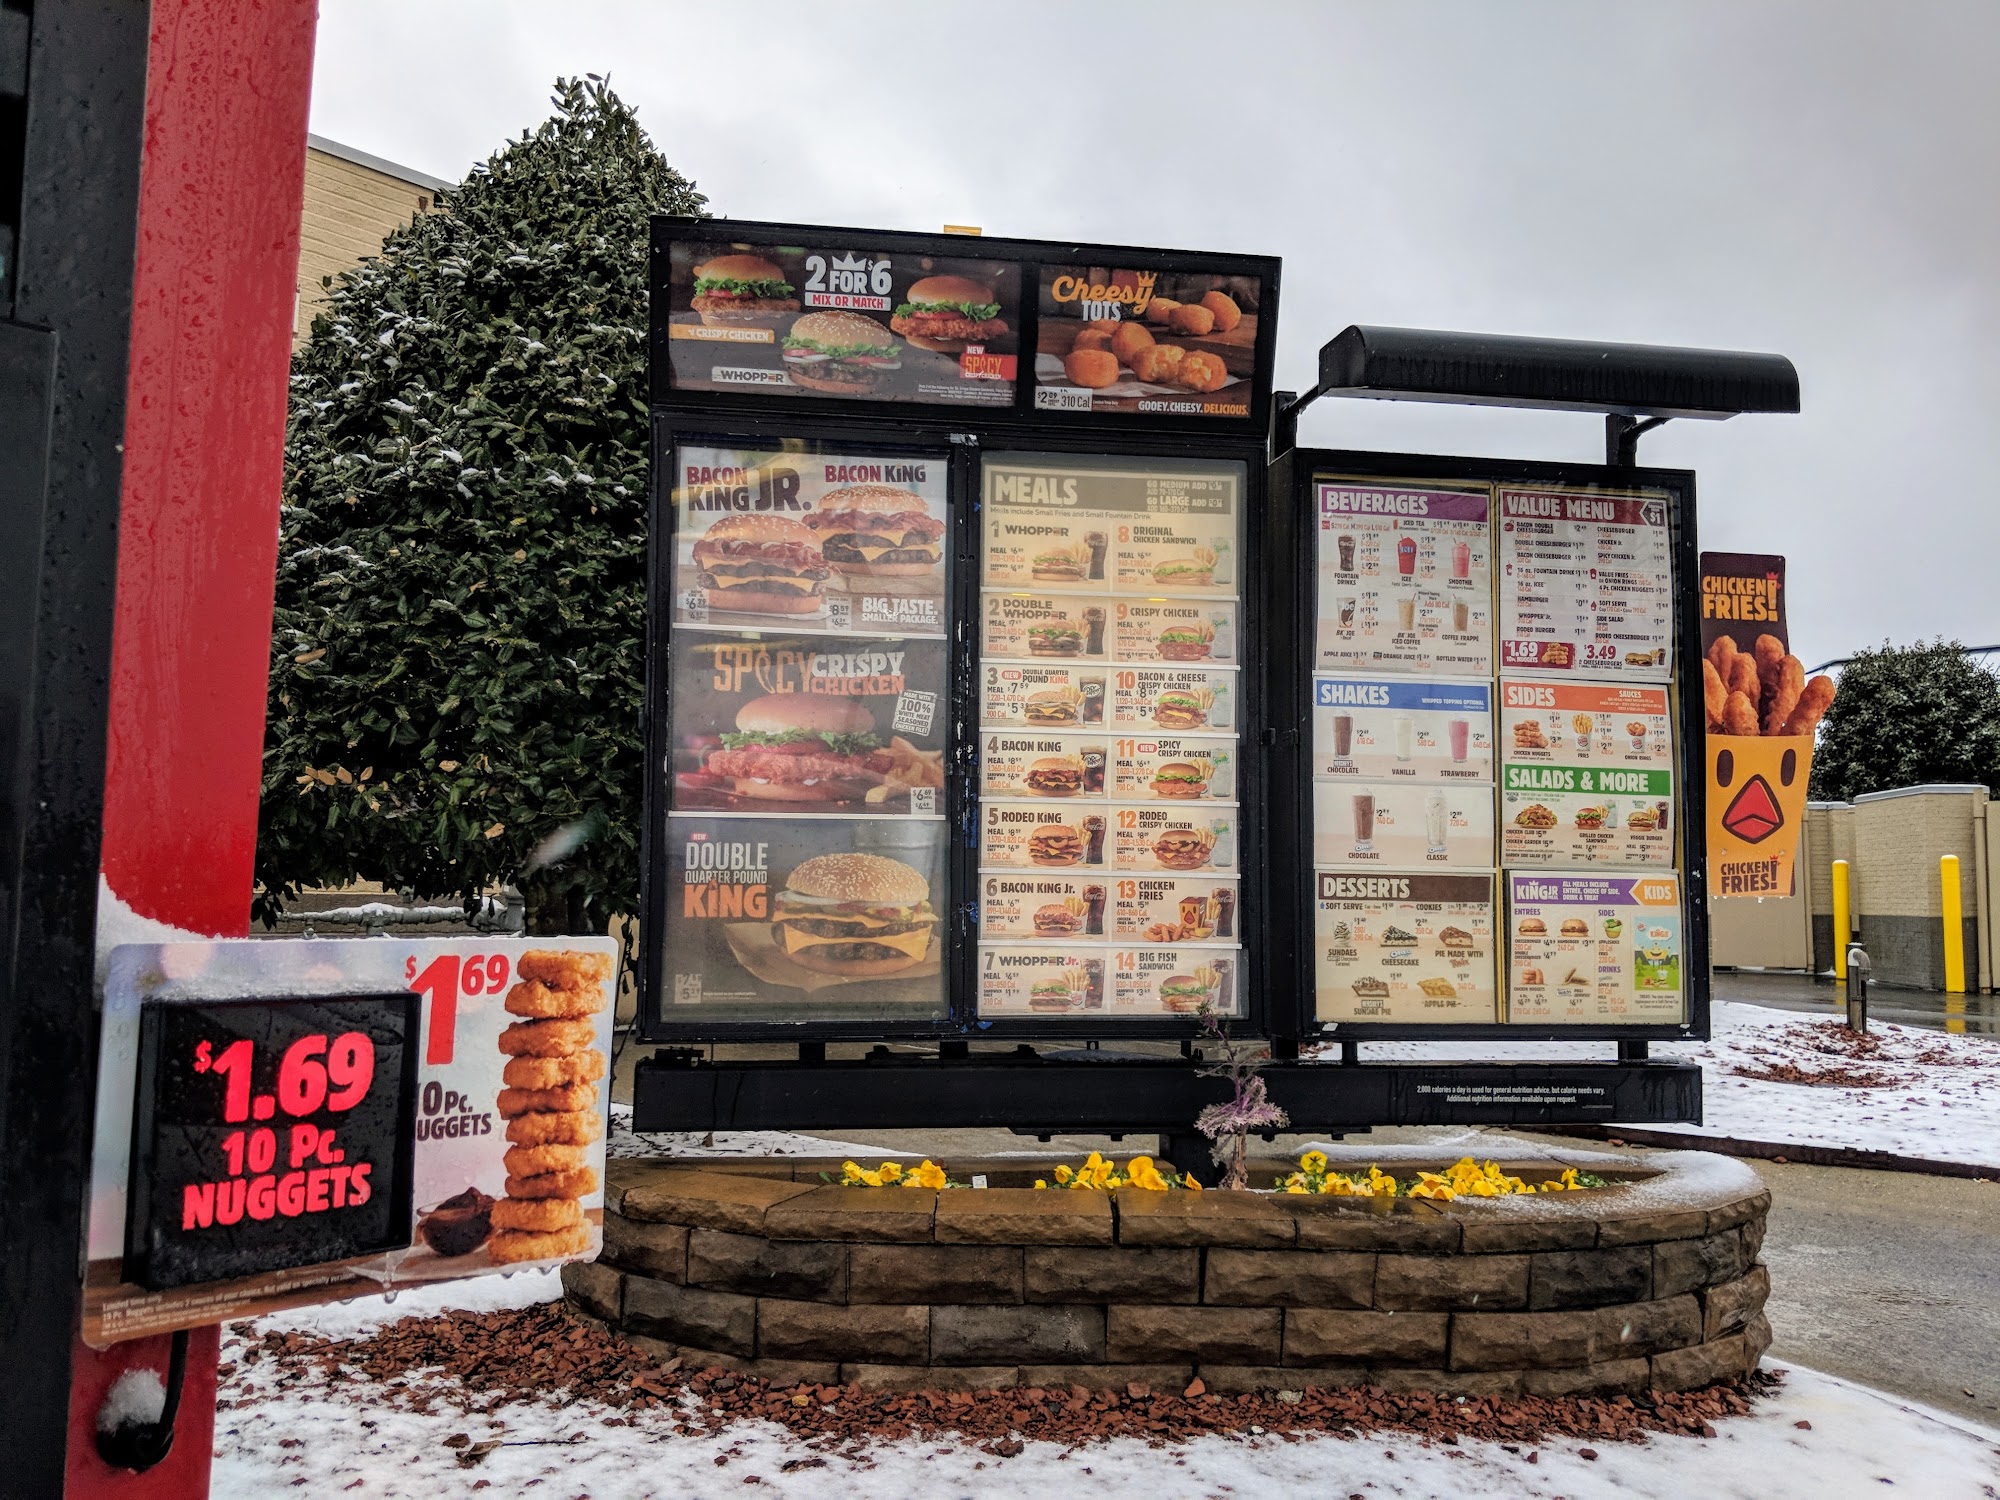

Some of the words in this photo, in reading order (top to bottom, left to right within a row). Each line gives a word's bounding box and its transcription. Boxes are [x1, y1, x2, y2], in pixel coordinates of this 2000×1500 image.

[805, 256, 827, 291] 2
[829, 271, 867, 294] FOR
[867, 260, 892, 295] $6
[812, 294, 832, 306] MIX
[835, 296, 849, 307] OR
[852, 297, 884, 309] MATCH
[1052, 275, 1156, 314] Cheesy
[1082, 300, 1121, 322] TOTS
[696, 330, 727, 338] CRISPY
[729, 330, 768, 341] CHICKEN
[967, 346, 984, 354] NEW
[966, 356, 1002, 374] SPICY
[721, 371, 784, 382] WHOPPER
[1061, 395, 1076, 407] 310
[1077, 396, 1090, 408] Cal
[1203, 404, 1248, 416] DELICIOUS.
[687, 466, 748, 485] BACON
[825, 465, 881, 483] BACON
[885, 465, 926, 483] KING
[689, 486, 749, 511] KING
[755, 468, 812, 511] JR.
[996, 475, 1078, 505] MEALS
[1327, 491, 1428, 515] BEVERAGES
[1507, 496, 1560, 517] VALUE
[1567, 500, 1615, 519] MENU
[1005, 525, 1068, 536] WHOPPER
[1118, 526, 1129, 543] 8
[1133, 527, 1173, 536] ORIGINAL
[1702, 576, 1767, 596] CHICKEN
[862, 598, 887, 613] BIG
[892, 598, 938, 616] TASTE.
[989, 599, 1000, 616] 2
[1003, 599, 1052, 609] DOUBLE
[1703, 580, 1778, 622] FRIES!
[862, 613, 898, 622] SMALLER
[900, 614, 938, 624] PACKAGE.
[1003, 609, 1067, 620] WHOPPER
[1117, 603, 1127, 620] 9
[1130, 608, 1160, 617] CRISPY
[1163, 608, 1198, 617] CHICKEN
[1505, 641, 1538, 657] $1.69
[1584, 645, 1616, 659] $3.49
[811, 652, 905, 677] CRISPY
[811, 675, 905, 695] CHICKEN
[988, 667, 998, 685] 3
[1050, 675, 1068, 684] KING
[1116, 671, 1135, 689] 10
[1138, 672, 1165, 680] BACON
[1168, 673, 1174, 681] &
[1177, 674, 1206, 682] CHEESE
[1163, 682, 1191, 690] CHICKEN
[1321, 684, 1389, 705] SHAKES
[1619, 690, 1641, 698] SAUCES
[1508, 686, 1555, 707] SIDES
[901, 699, 930, 713] 100%
[988, 736, 998, 754] 4
[1002, 741, 1034, 751] BACON
[1037, 741, 1061, 752] KING
[1117, 740, 1134, 757] 11
[1158, 741, 1181, 749] SPICY
[1509, 768, 1574, 789] SALADS
[1580, 771, 1593, 790] &
[1600, 773, 1649, 792] MORE
[988, 808, 998, 825] 5
[1002, 812, 1034, 822] RODEO
[1037, 813, 1061, 823] KING
[1117, 811, 1136, 828] 12
[1140, 811, 1167, 820] RODEO
[686, 843, 768, 870] DOUBLE
[685, 870, 730, 883] QUARTER
[734, 870, 767, 884] POUND
[1721, 861, 1768, 875] CHICKEN
[1721, 860, 1778, 894] FRIES!
[986, 879, 997, 896] 6
[1001, 882, 1033, 893] BACON
[1037, 883, 1061, 893] KING
[1064, 884, 1075, 894] Jr.
[1117, 881, 1136, 898] 13
[1139, 881, 1174, 890] CHICKEN
[1139, 891, 1163, 900] FRIES
[1323, 877, 1410, 898] DESSERTS
[1644, 886, 1672, 899] KIDS
[684, 883, 767, 918] KING
[985, 952, 995, 970] 7
[999, 956, 1065, 966] WHOPPER
[1065, 957, 1079, 965] Jr.
[1116, 952, 1135, 970] 14
[1139, 953, 1154, 961] BIG
[1158, 953, 1177, 962] FISH
[194, 1031, 374, 1123] $1.69
[1457, 1086, 1466, 1095] day
[1493, 1086, 1511, 1095] general
[1557, 1096, 1576, 1104] request.
[417, 1113, 491, 1141] UGGETS
[223, 1127, 276, 1176] 10
[291, 1124, 345, 1166] Pc.
[183, 1162, 371, 1231] NUGGETS
